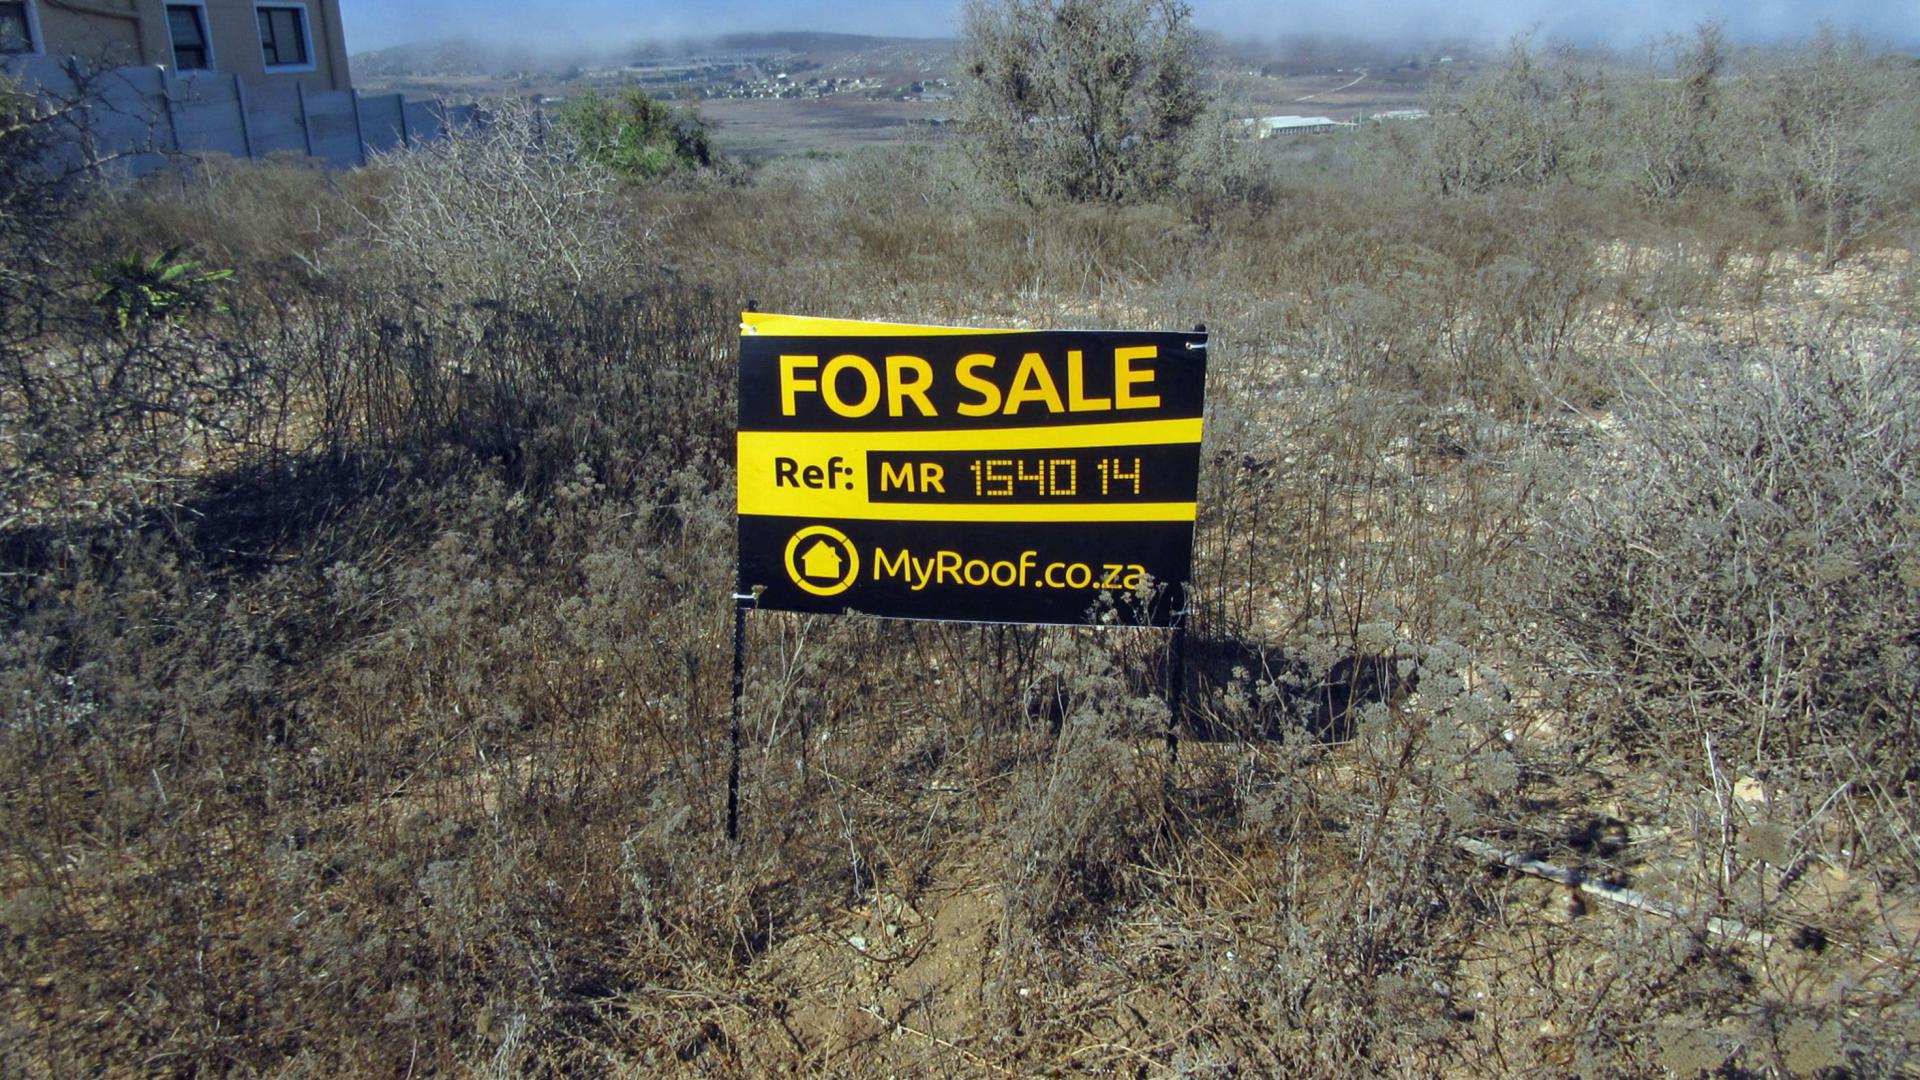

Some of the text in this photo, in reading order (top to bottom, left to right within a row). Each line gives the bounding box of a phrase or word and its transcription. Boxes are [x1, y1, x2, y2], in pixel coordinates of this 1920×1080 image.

[779, 345, 1161, 418] FOR SALE
[775, 456, 1141, 496] Ref: MR 1540 14
[873, 549, 1147, 591] MyRoof.co.za
